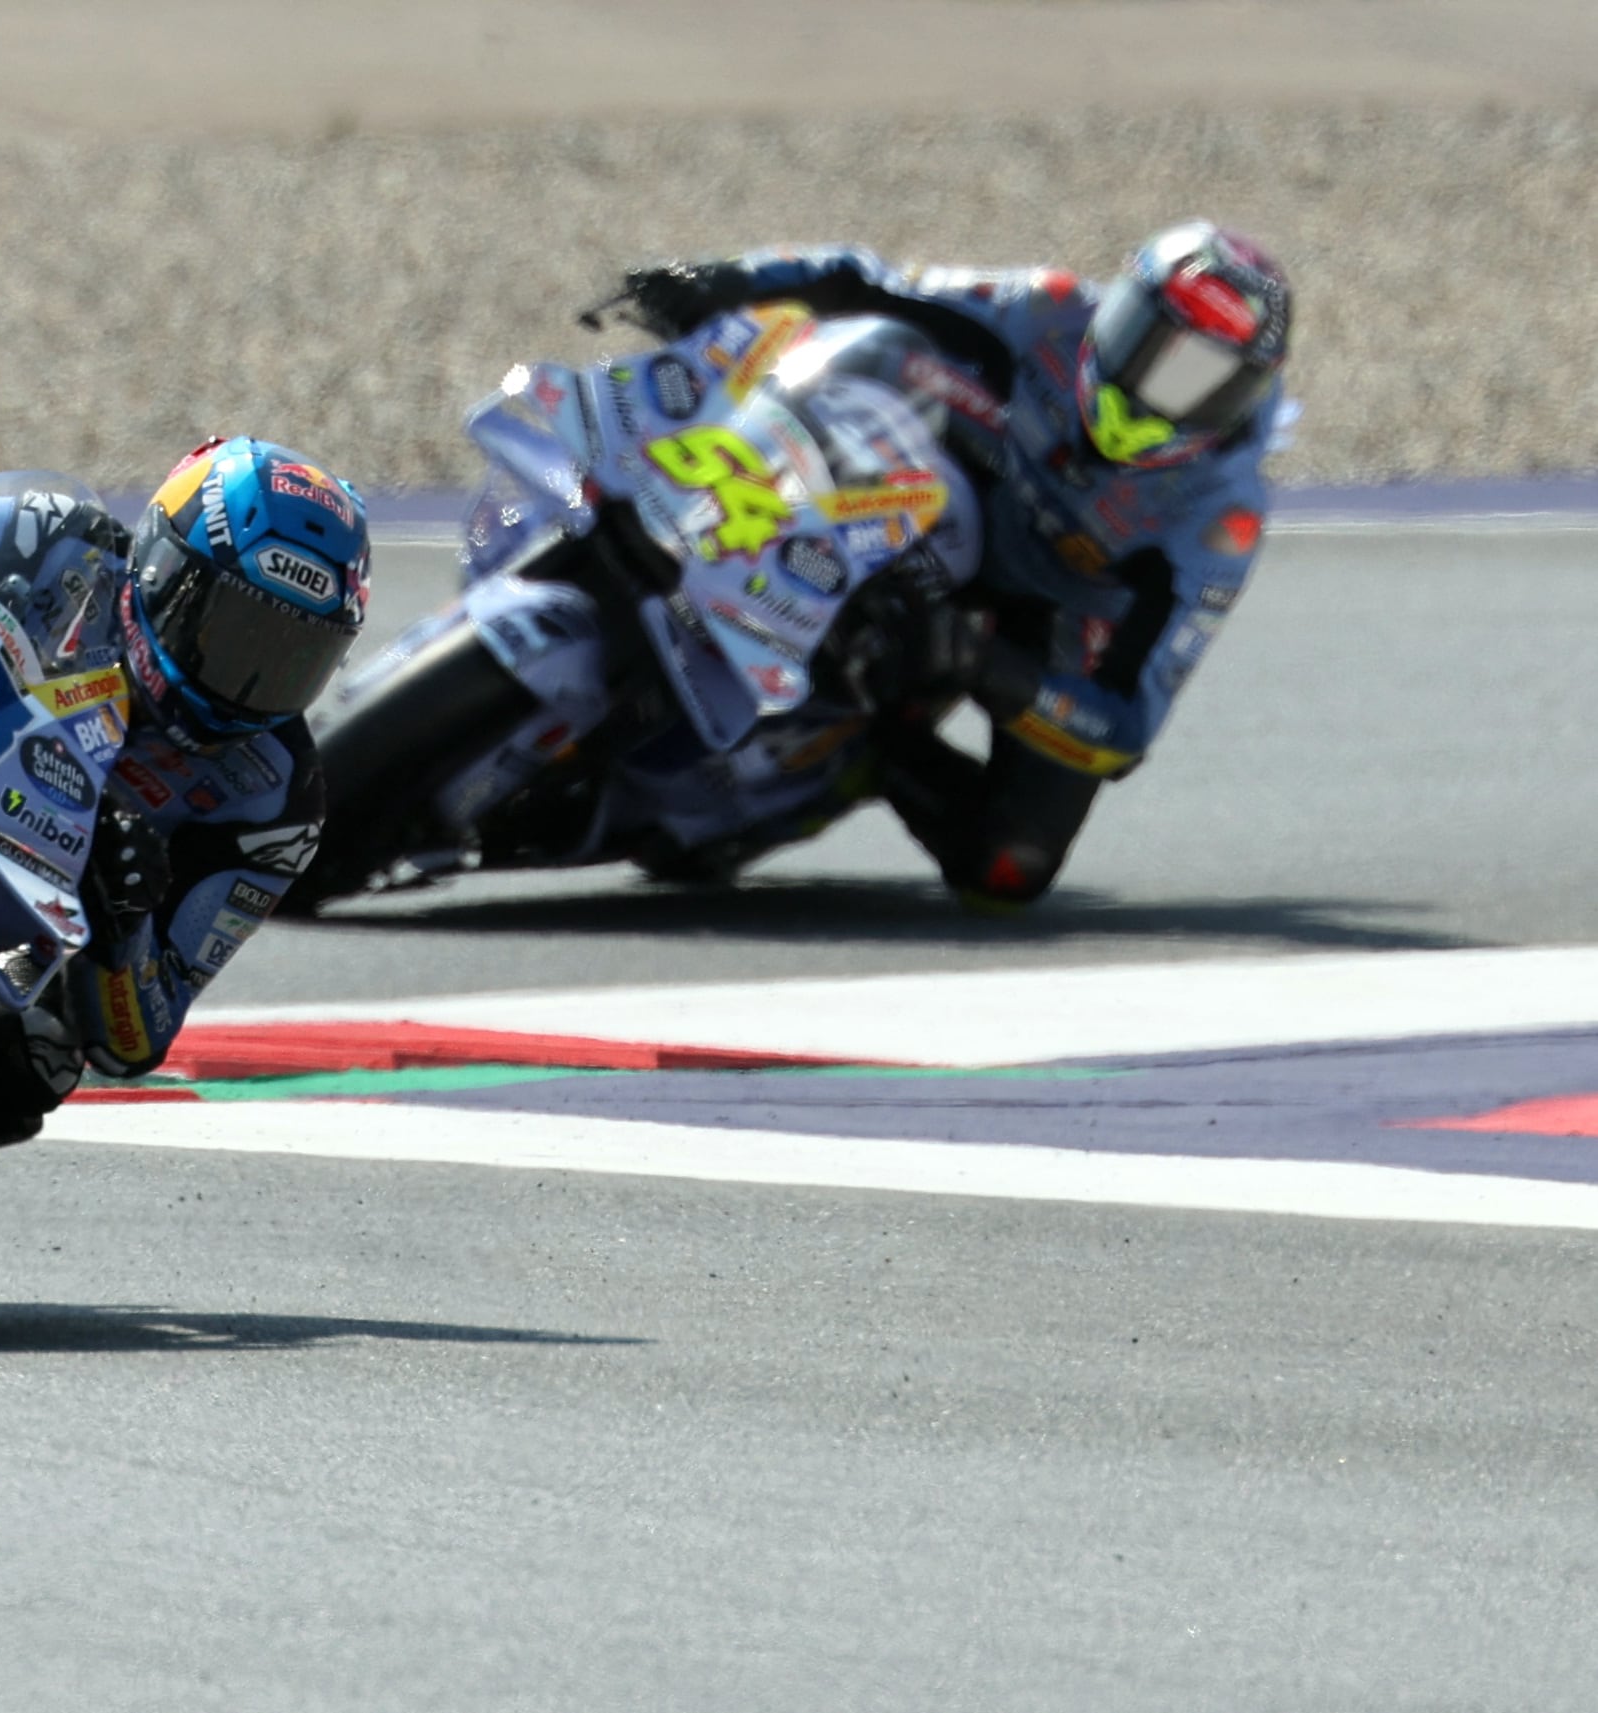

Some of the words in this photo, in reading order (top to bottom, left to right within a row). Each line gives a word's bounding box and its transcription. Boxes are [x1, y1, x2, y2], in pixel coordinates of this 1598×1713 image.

[271, 475, 317, 502] Red
[317, 486, 353, 530] Bull
[643, 424, 792, 556] 54
[220, 571, 264, 602] GIVES
[271, 595, 302, 619] YOU
[266, 551, 329, 598] SHOEI
[32, 743, 86, 787] Estrella
[33, 760, 83, 801] Galicia
[233, 882, 272, 909] BOLD
